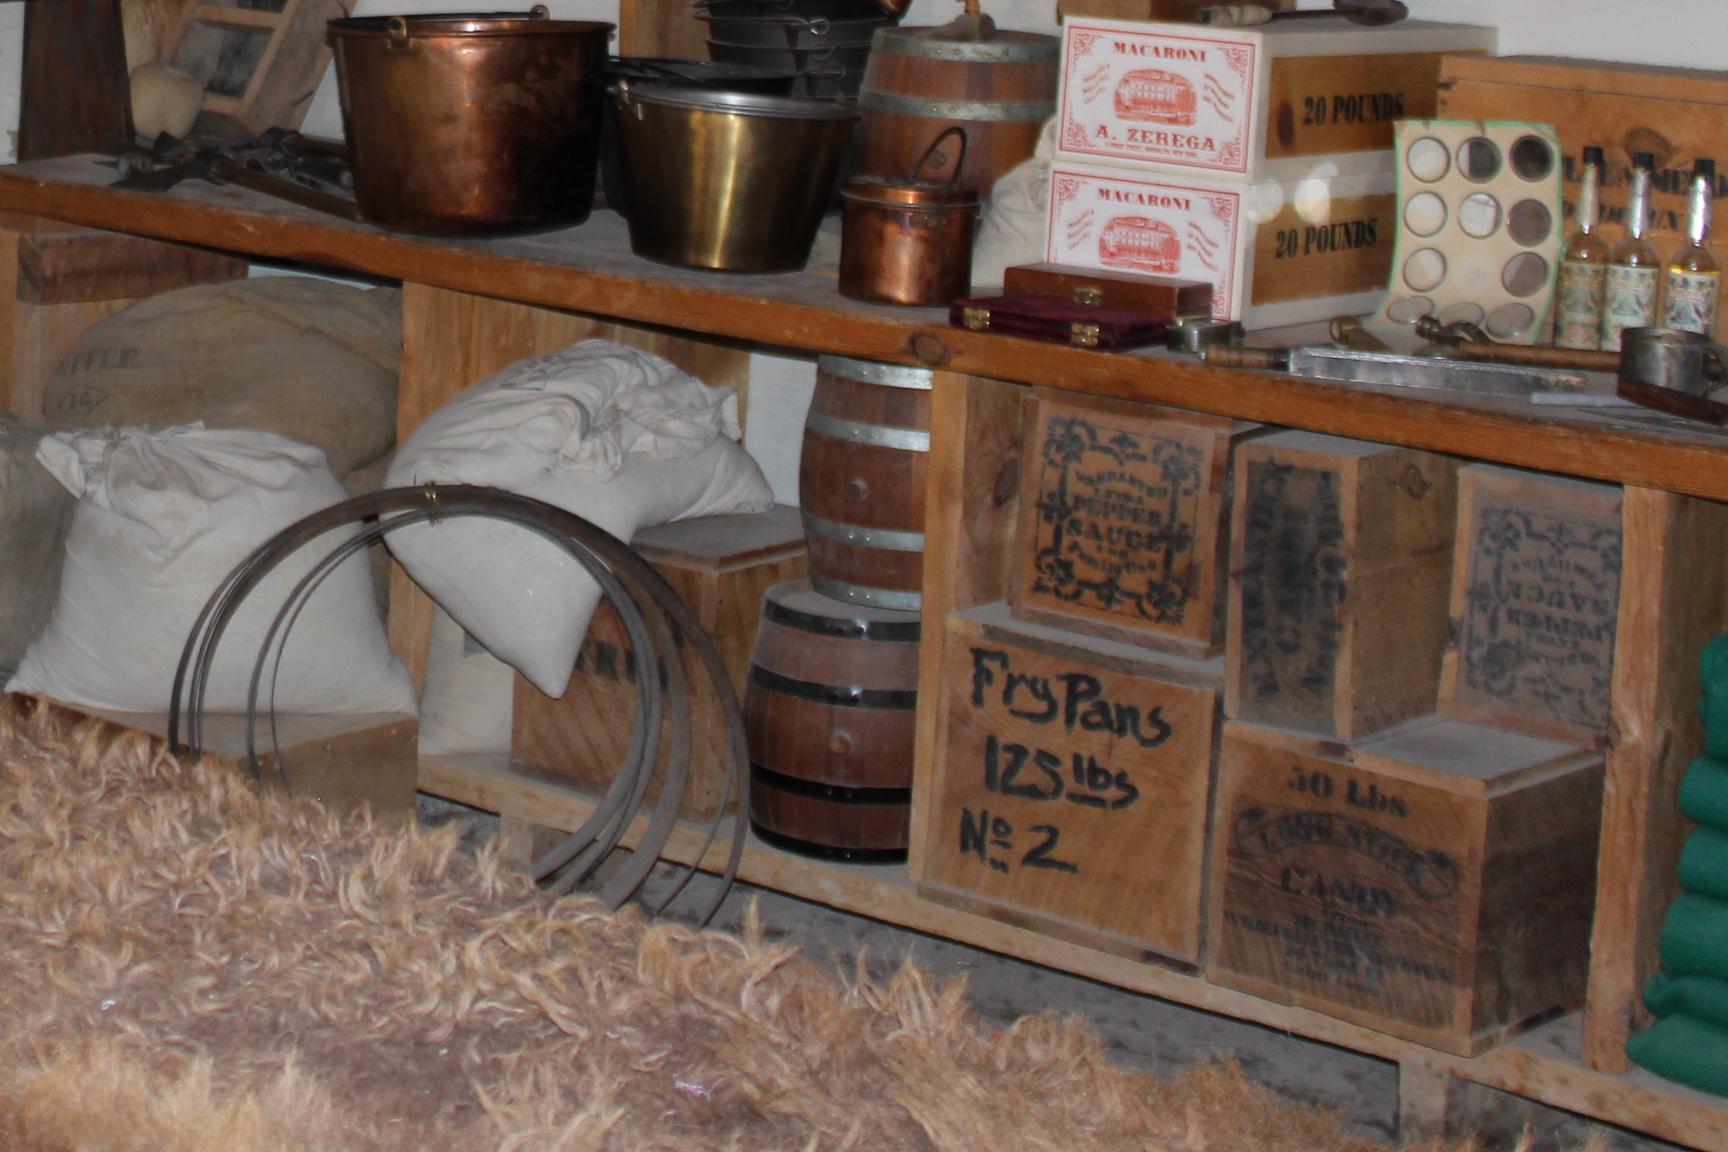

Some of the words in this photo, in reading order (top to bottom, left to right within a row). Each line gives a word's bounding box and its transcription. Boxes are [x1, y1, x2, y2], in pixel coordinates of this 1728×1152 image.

[1113, 41, 1207, 63] MACARONI
[1303, 95, 1327, 126] 20
[1332, 92, 1406, 124] POUNDS
[1095, 125, 1117, 140] A.
[1127, 128, 1215, 151] ZEREGA
[1098, 188, 1192, 211] MACARONI
[1275, 228, 1299, 259] 20
[1304, 219, 1378, 256] POUNDS
[1067, 517, 1161, 553] SAUCE
[969, 646, 1059, 725] Fry
[1057, 672, 1172, 747] Pans
[985, 734, 1065, 801] 125
[1021, 824, 1079, 874] 2
